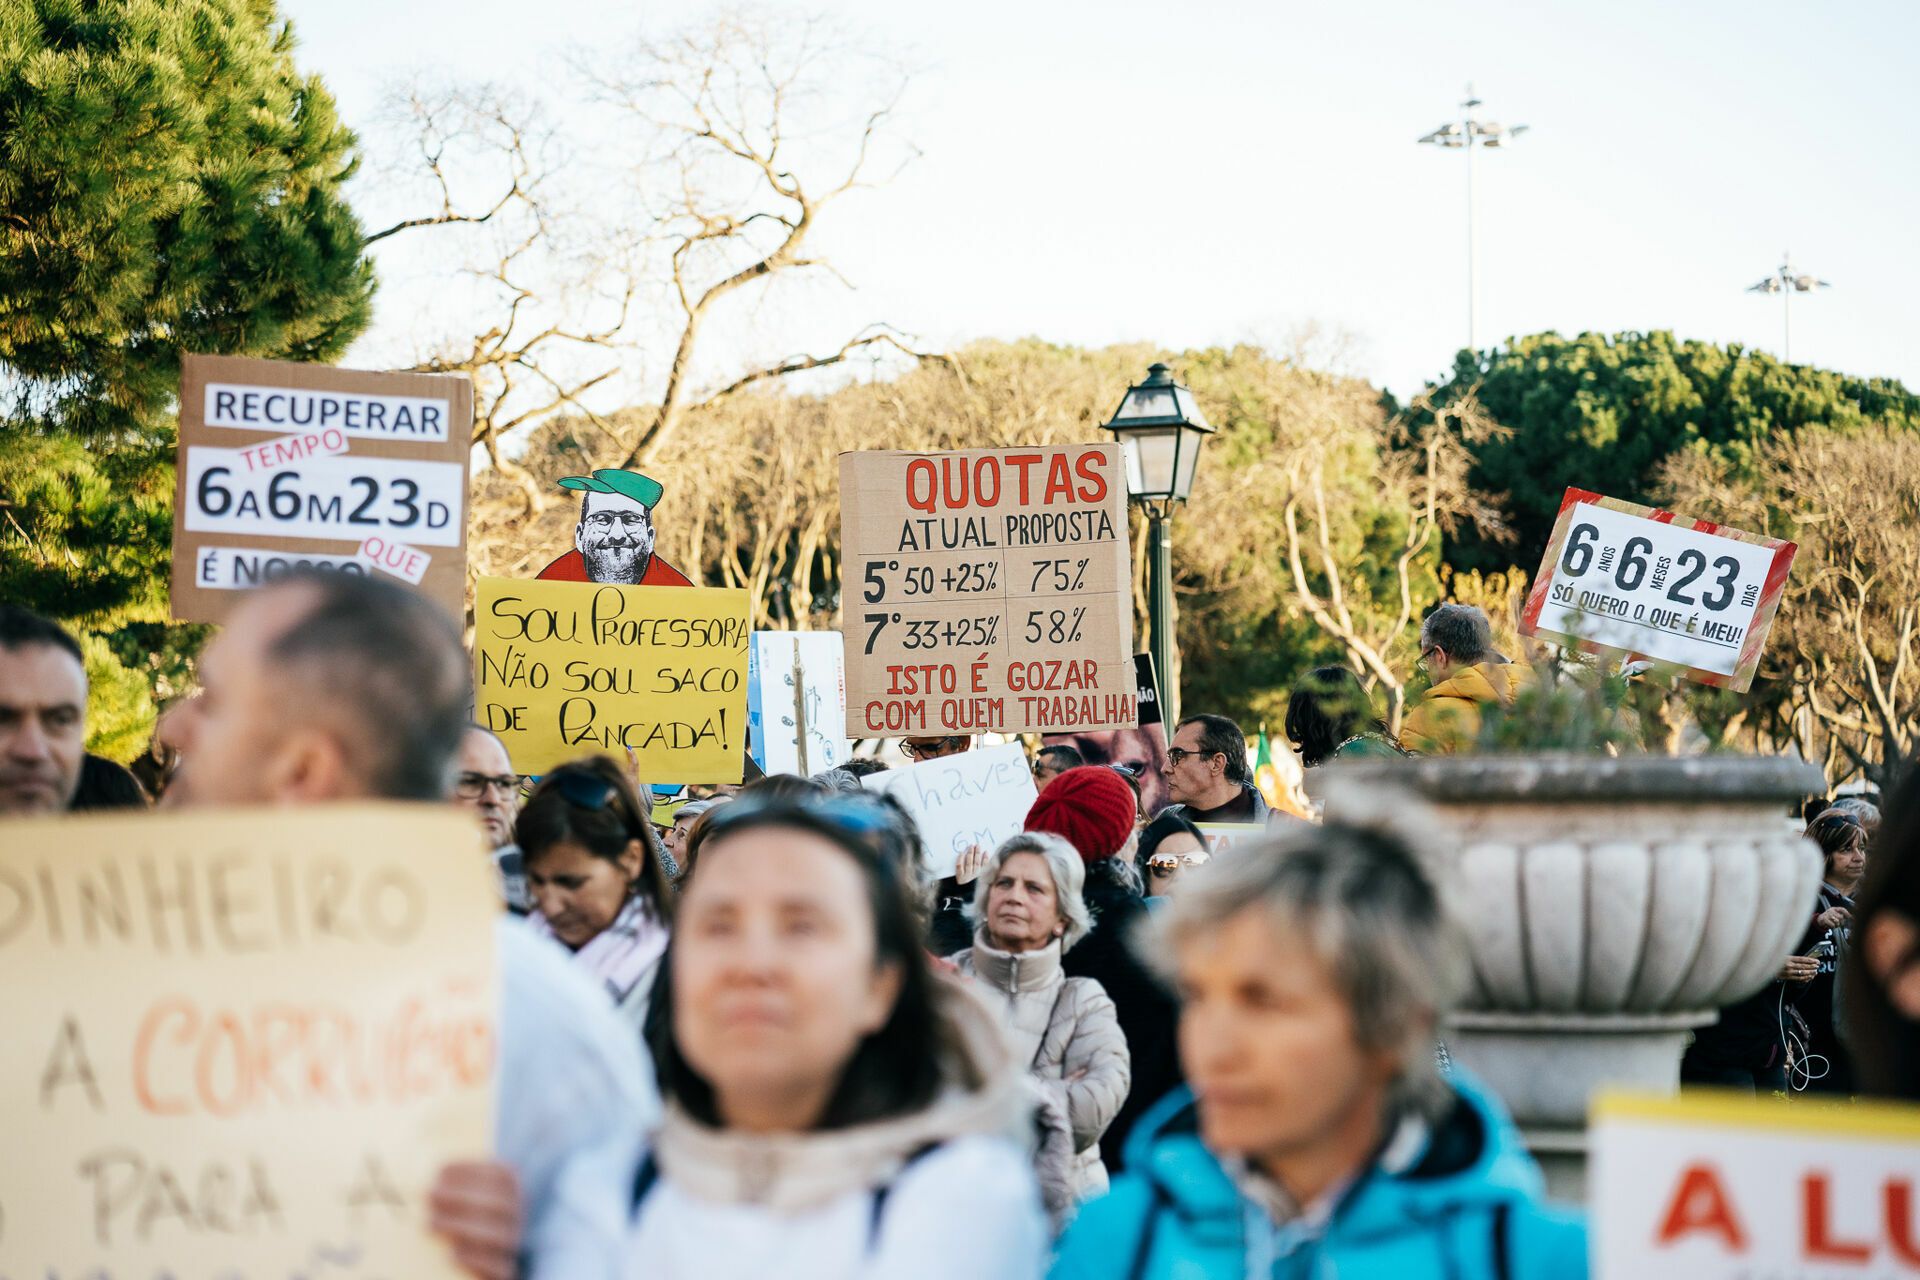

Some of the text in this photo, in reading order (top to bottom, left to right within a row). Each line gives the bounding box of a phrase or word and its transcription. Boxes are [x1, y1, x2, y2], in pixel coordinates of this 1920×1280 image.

[215, 391, 441, 435] RECUPERAR
[240, 428, 343, 473] TEMPO
[905, 450, 1108, 514] QUOTAS
[898, 509, 1116, 552] ATUAL PROPOSTA
[202, 551, 218, 582] É
[363, 536, 423, 577] QUE
[1030, 558, 1090, 593] 75%
[1561, 523, 1759, 611] 6 ANOS 6 MESES 23 DIAS
[1025, 607, 1087, 644] 58%
[1552, 580, 1574, 603] SÓ
[1578, 589, 1630, 617] QUERO
[1633, 604, 1646, 620] O
[1650, 608, 1682, 630] QUE
[1701, 620, 1743, 645] MEU!
[481, 644, 739, 695] NÃO SOU SACO
[886, 663, 957, 695] ISTO
[970, 652, 989, 693] É
[1007, 659, 1099, 692] GOZAR
[486, 703, 528, 732] DE
[865, 694, 1137, 731] COM QUEM TRABALHA!
[38, 1011, 106, 1113] A
[77, 1144, 288, 1250] PARA
[1656, 1162, 1746, 1252] A
